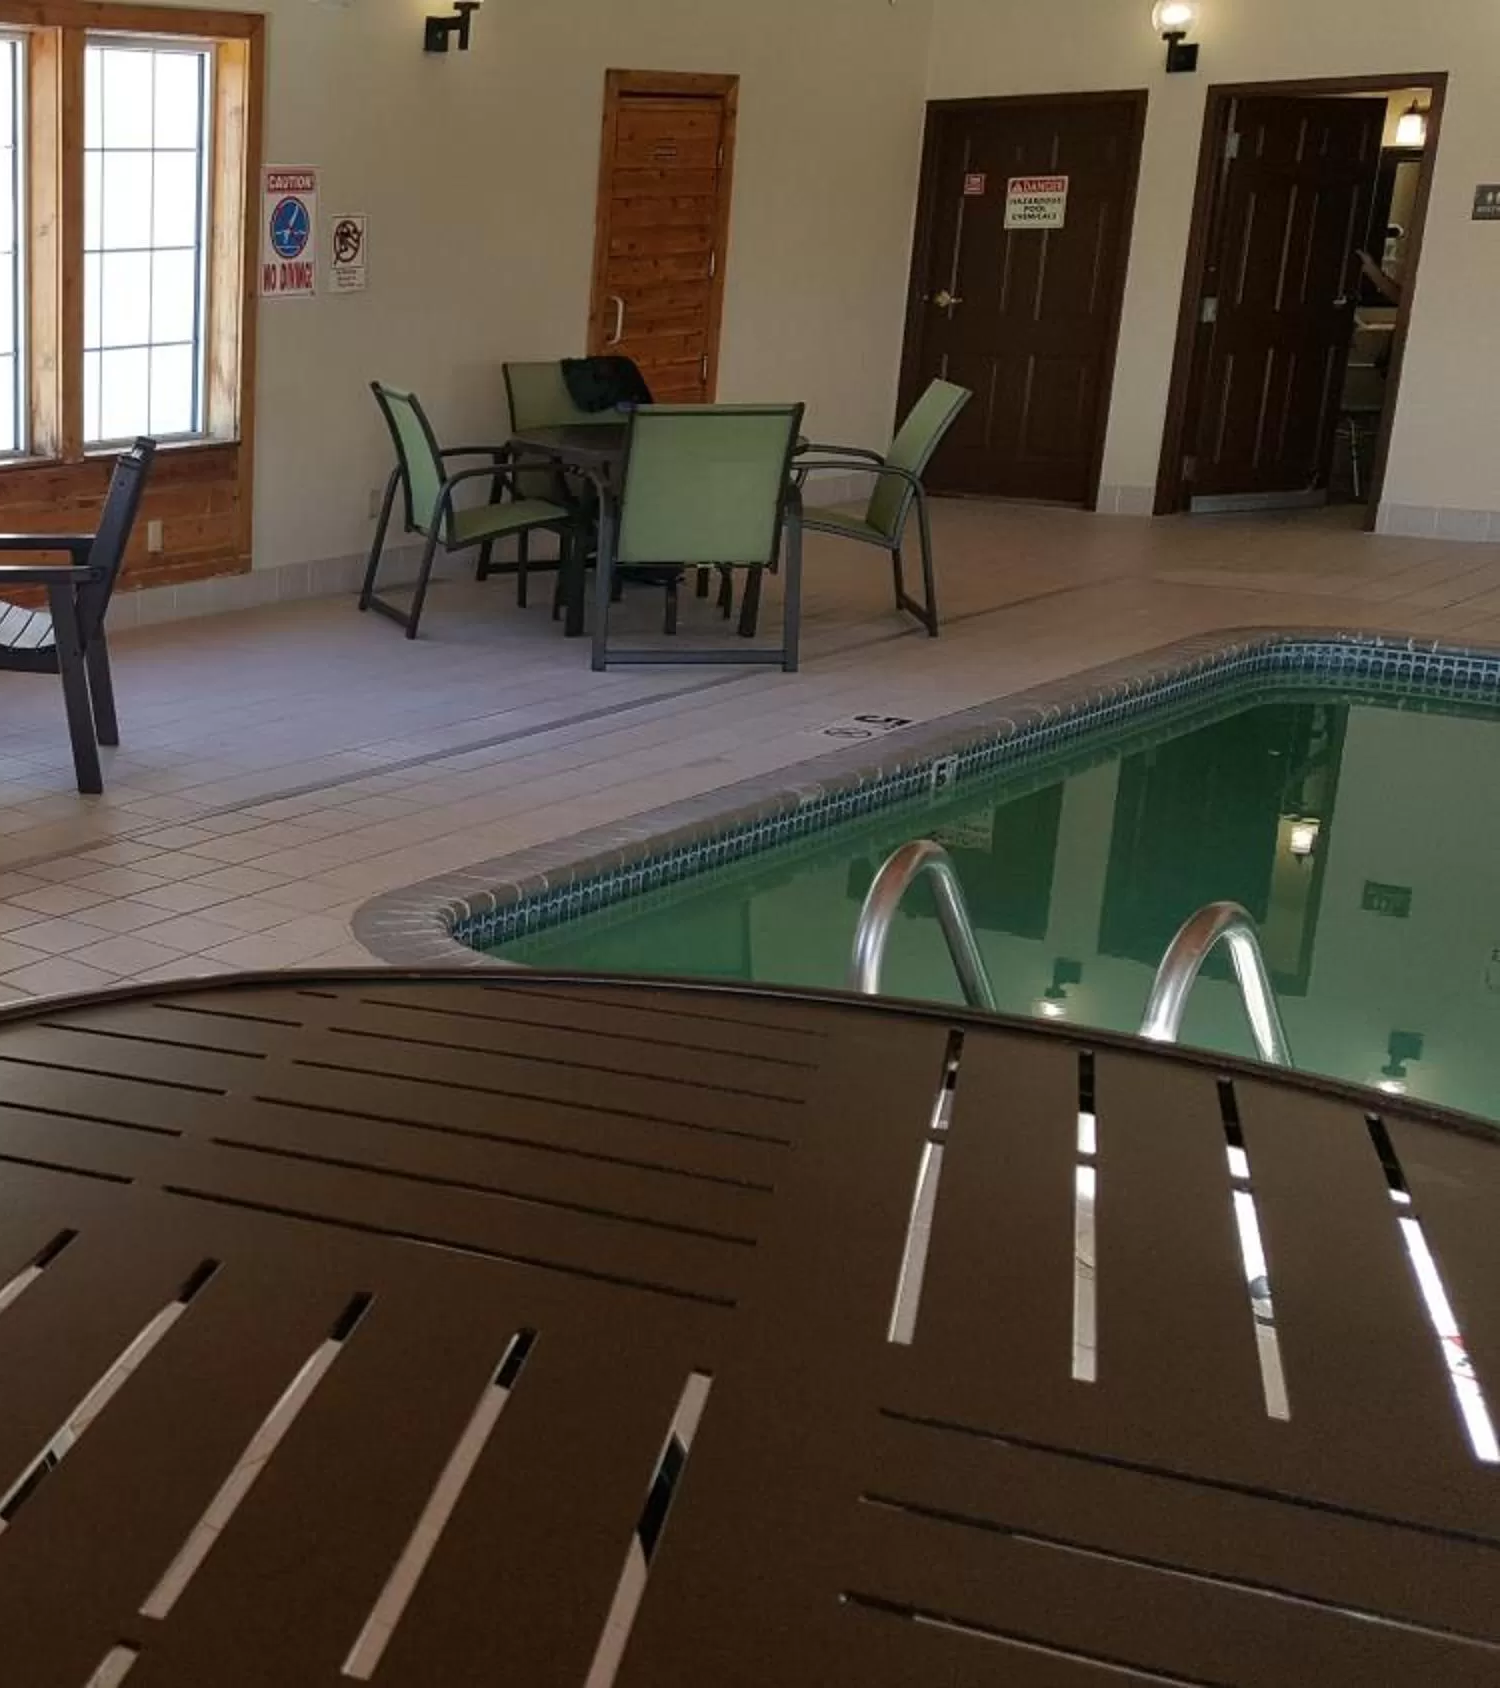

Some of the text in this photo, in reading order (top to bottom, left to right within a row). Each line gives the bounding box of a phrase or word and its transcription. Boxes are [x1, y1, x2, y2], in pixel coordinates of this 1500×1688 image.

[269, 175, 312, 189] CAUTION
[1024, 181, 1062, 192] DANGER
[262, 263, 277, 292] NO
[280, 261, 313, 291] DIVING
